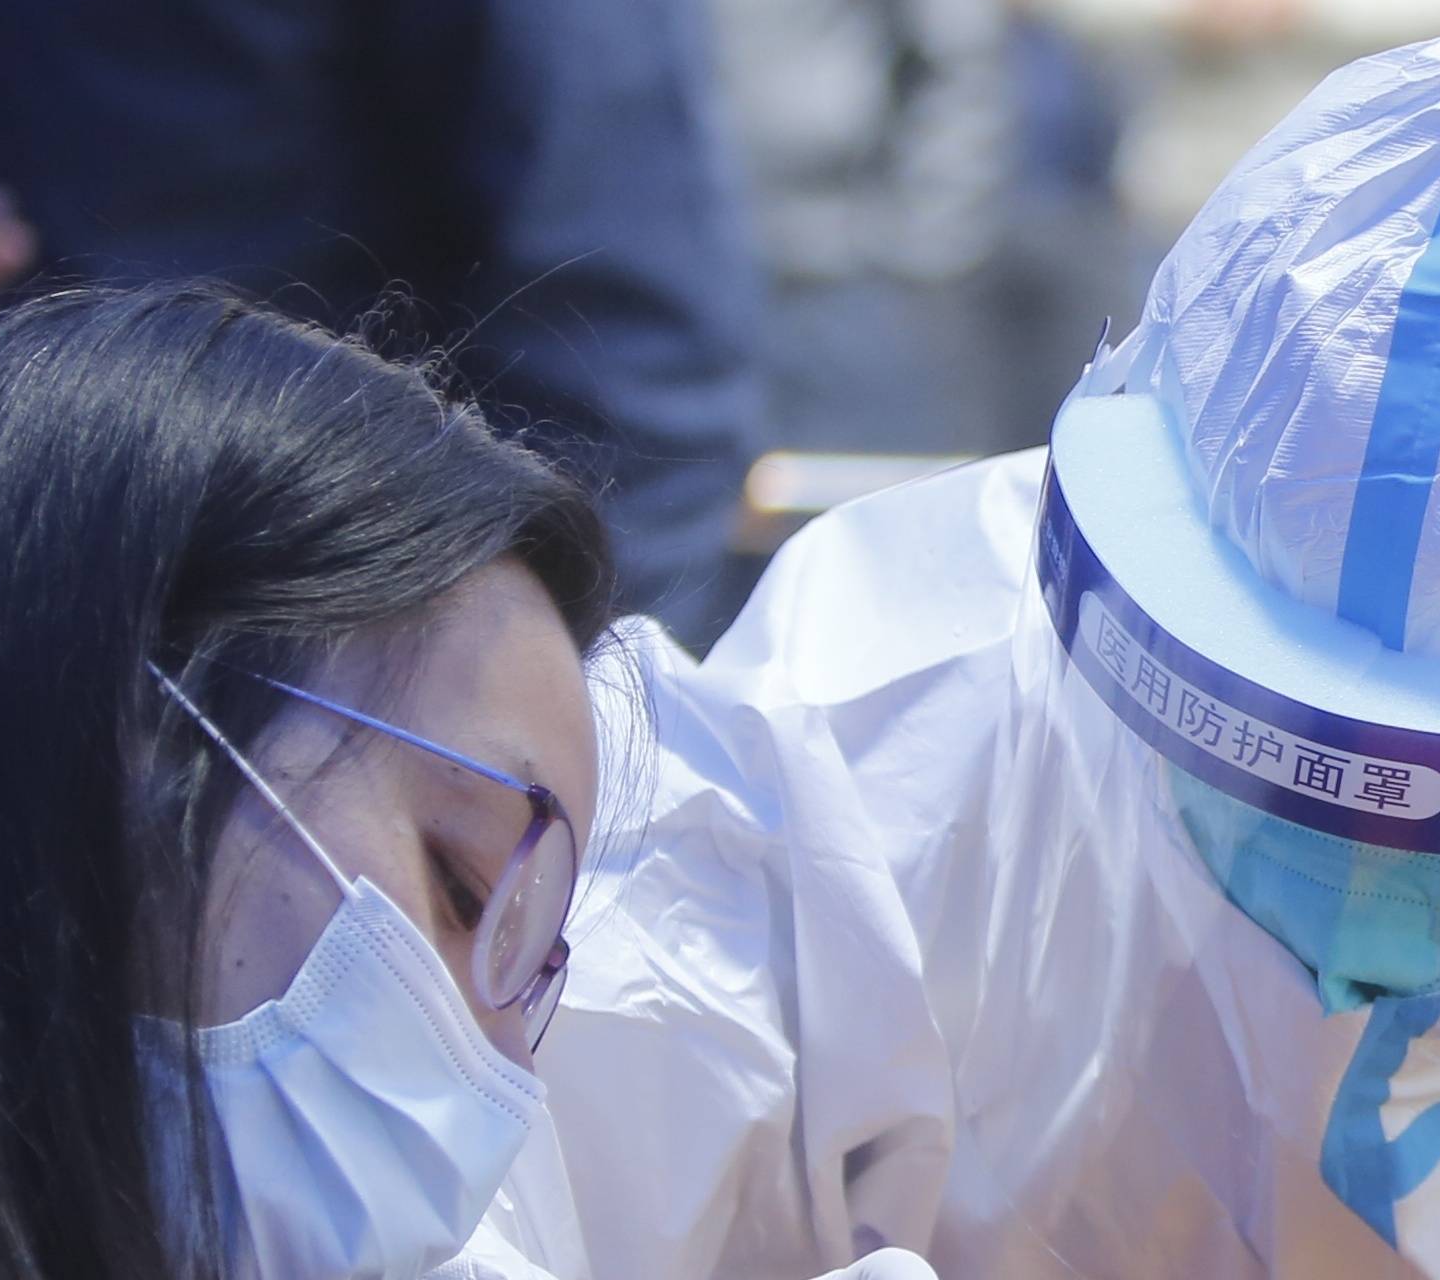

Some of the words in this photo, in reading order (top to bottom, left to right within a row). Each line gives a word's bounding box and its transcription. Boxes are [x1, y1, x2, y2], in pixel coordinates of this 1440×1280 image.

[1096, 612, 1412, 810] 医用防护面罩
